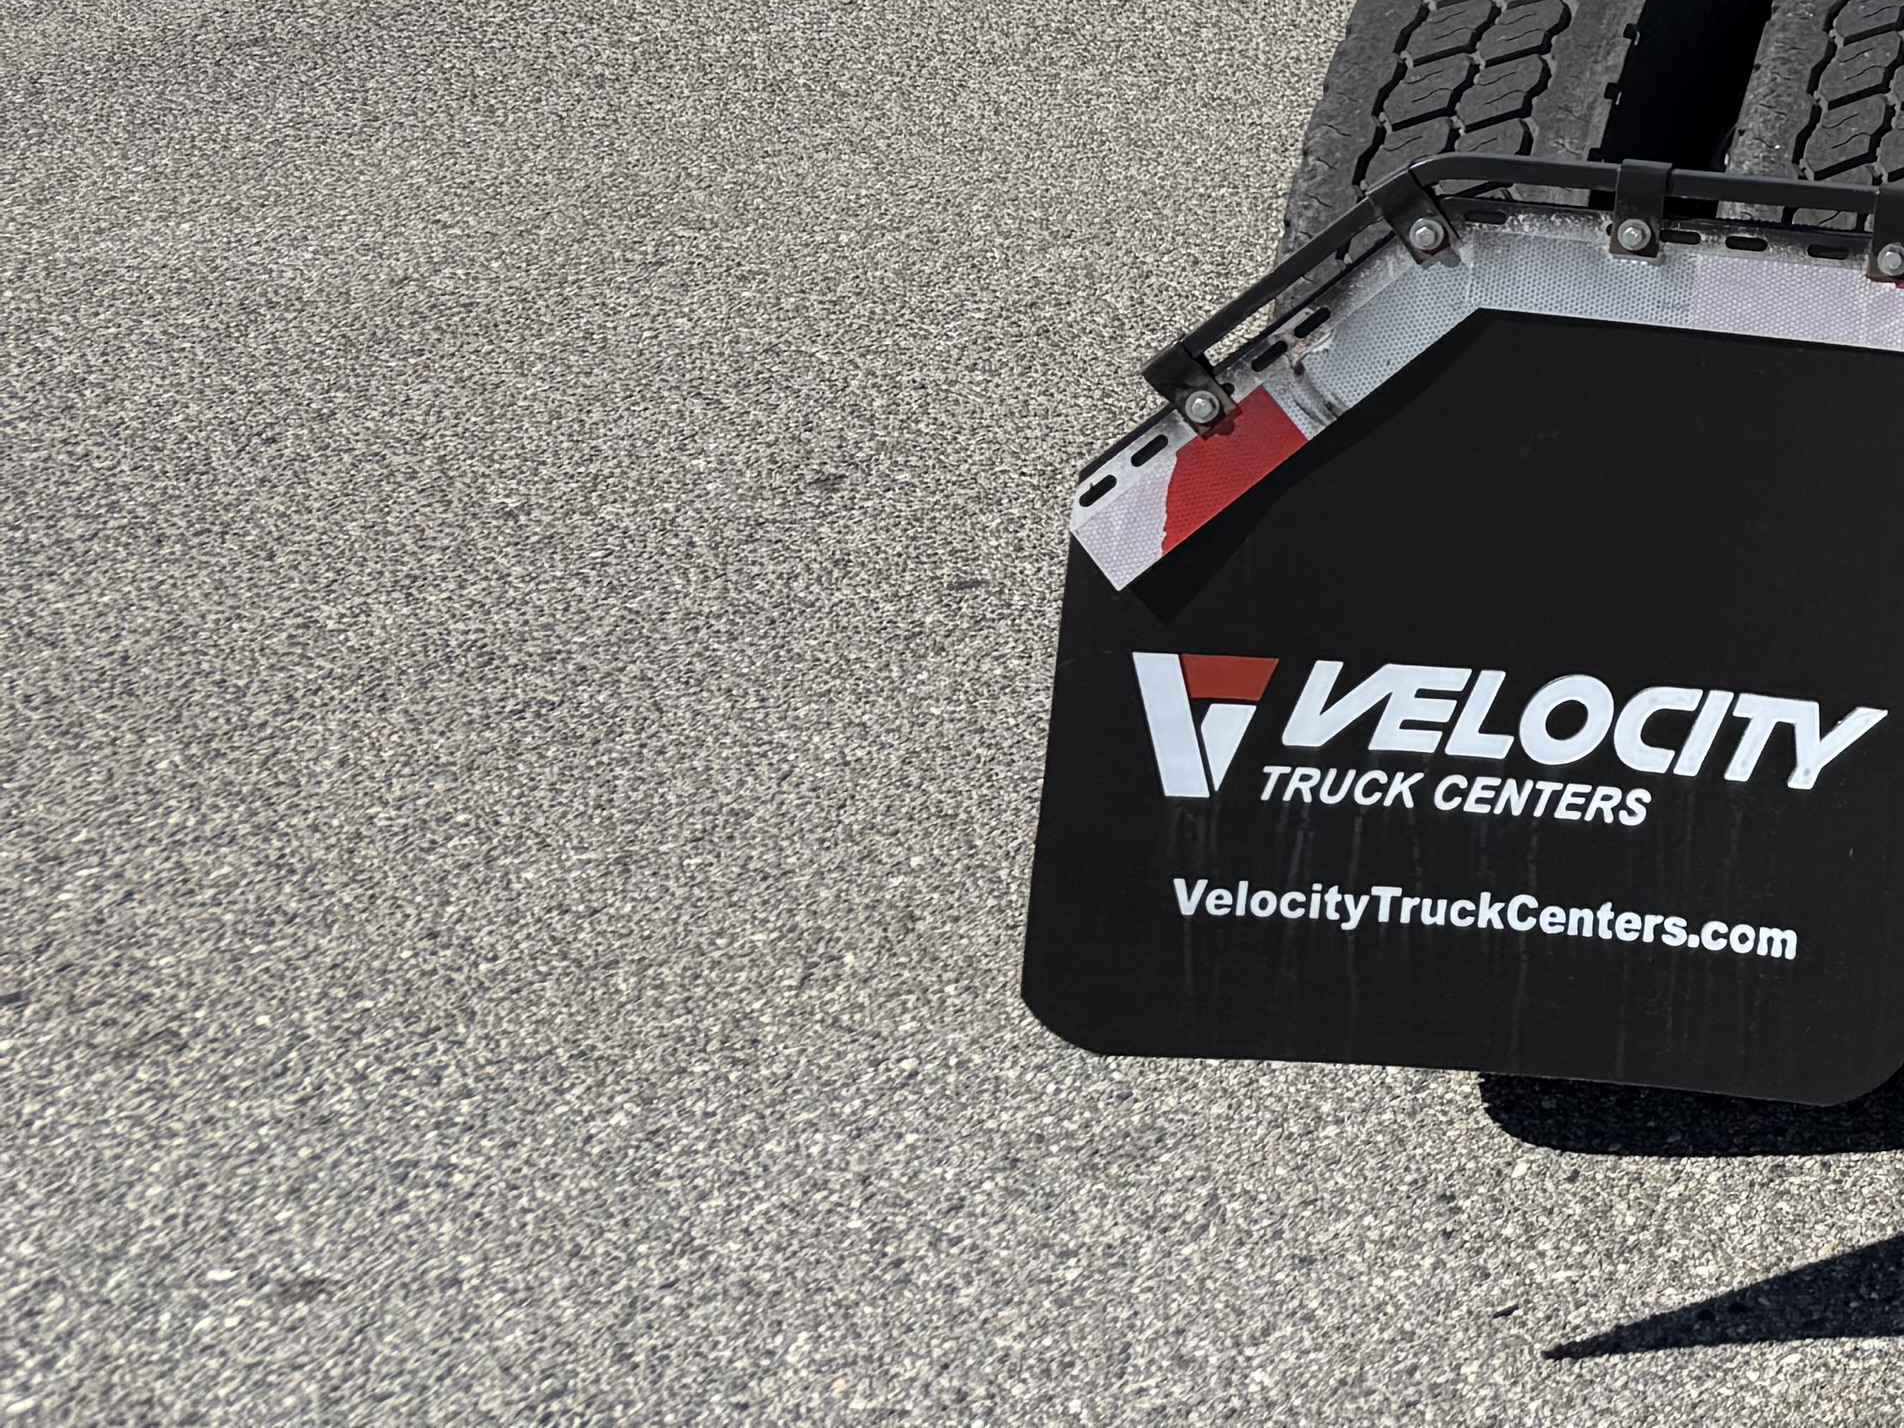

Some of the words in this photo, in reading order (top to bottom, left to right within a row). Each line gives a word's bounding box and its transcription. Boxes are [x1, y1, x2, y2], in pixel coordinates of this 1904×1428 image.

[1281, 659, 1889, 790] VELOCITY
[1260, 765, 1425, 809] TRUCK
[1433, 774, 1652, 827] CENTERS
[1173, 878, 1798, 961] VelocityTruckCenters.com
